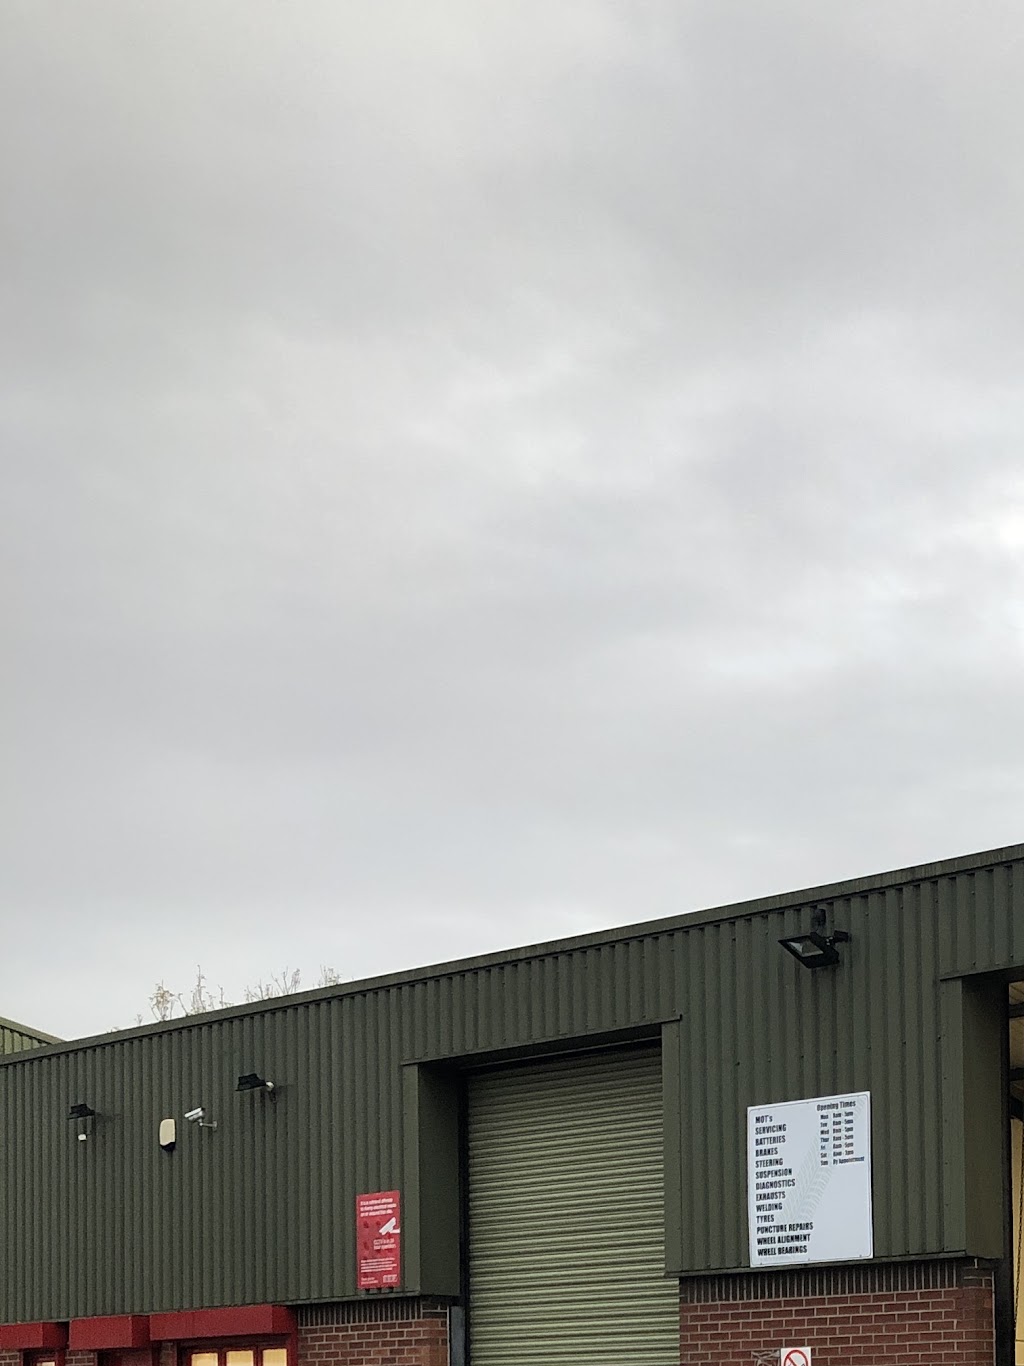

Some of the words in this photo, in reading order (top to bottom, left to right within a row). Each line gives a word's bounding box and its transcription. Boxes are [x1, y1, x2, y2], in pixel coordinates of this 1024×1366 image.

[817, 1103, 838, 1111] Opening
[755, 1124, 786, 1135] SERVICING
[755, 1135, 785, 1146] BATTERIES
[755, 1147, 778, 1157] BRAKES
[755, 1158, 783, 1168] STEERING
[755, 1168, 792, 1179] SUSPENSION
[756, 1179, 795, 1190] DIAGNOSTICS
[756, 1191, 785, 1201] EXHAUSTS
[756, 1203, 782, 1212] WELDING
[756, 1215, 774, 1223] TYRES
[757, 1224, 787, 1234] PUNCTURE
[788, 1222, 813, 1231] REPAIRS
[757, 1236, 776, 1245] WHEEL
[778, 1234, 810, 1243] ALIGNMENT
[757, 1247, 776, 1256] WHEEL
[778, 1245, 807, 1254] BEARINGS
